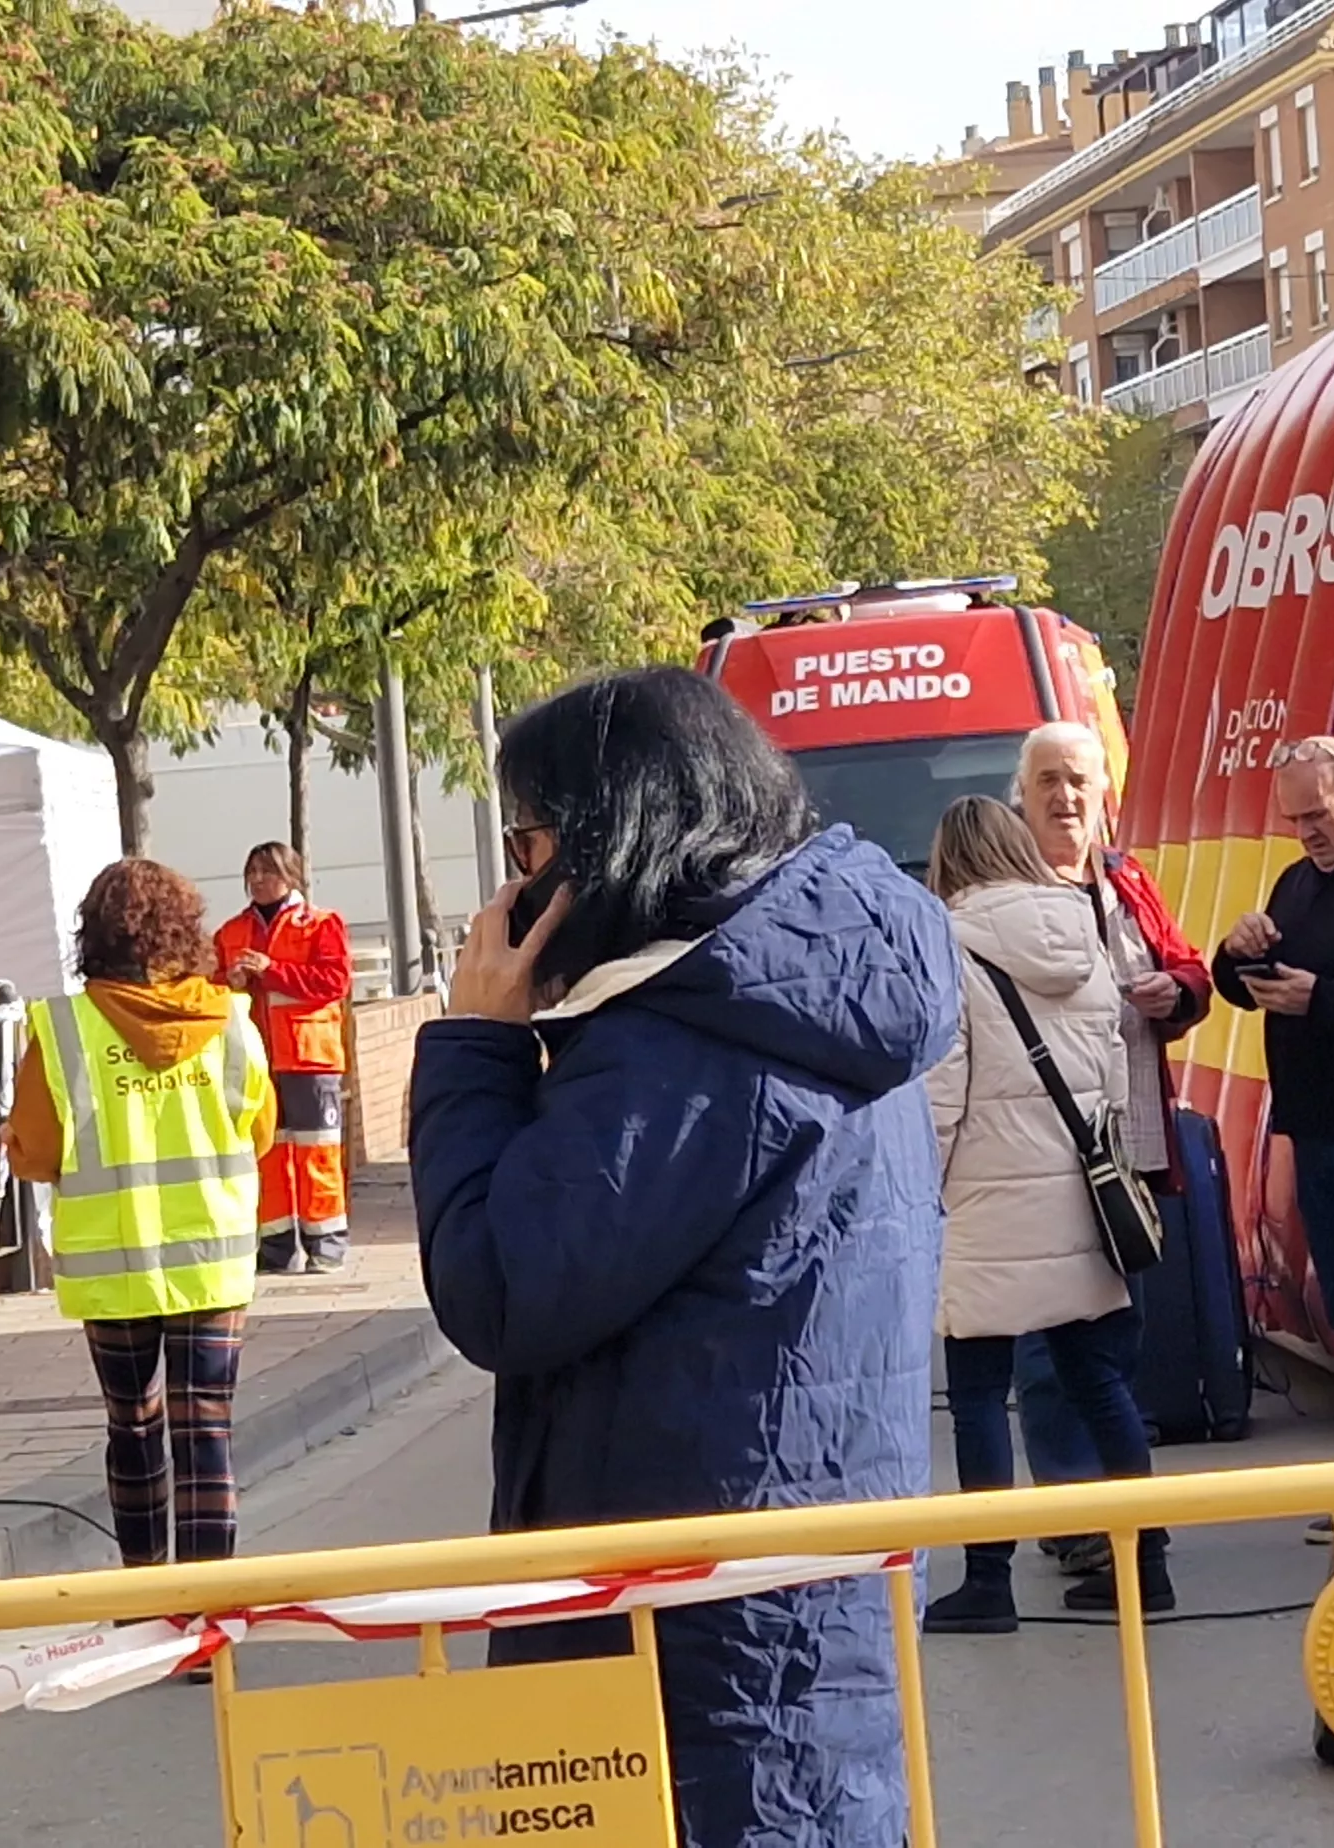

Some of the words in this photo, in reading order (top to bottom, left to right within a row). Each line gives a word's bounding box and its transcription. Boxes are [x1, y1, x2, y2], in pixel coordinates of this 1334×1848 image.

[794, 644, 945, 681] PUESTO
[770, 686, 819, 717] DE
[830, 673, 971, 707] MANDO
[115, 1069, 211, 1096] Sociales
[45, 1633, 105, 1662] Huesca
[401, 1746, 648, 1803] Ayuntamiento
[402, 1811, 448, 1844] de
[458, 1802, 596, 1839] Huesca
